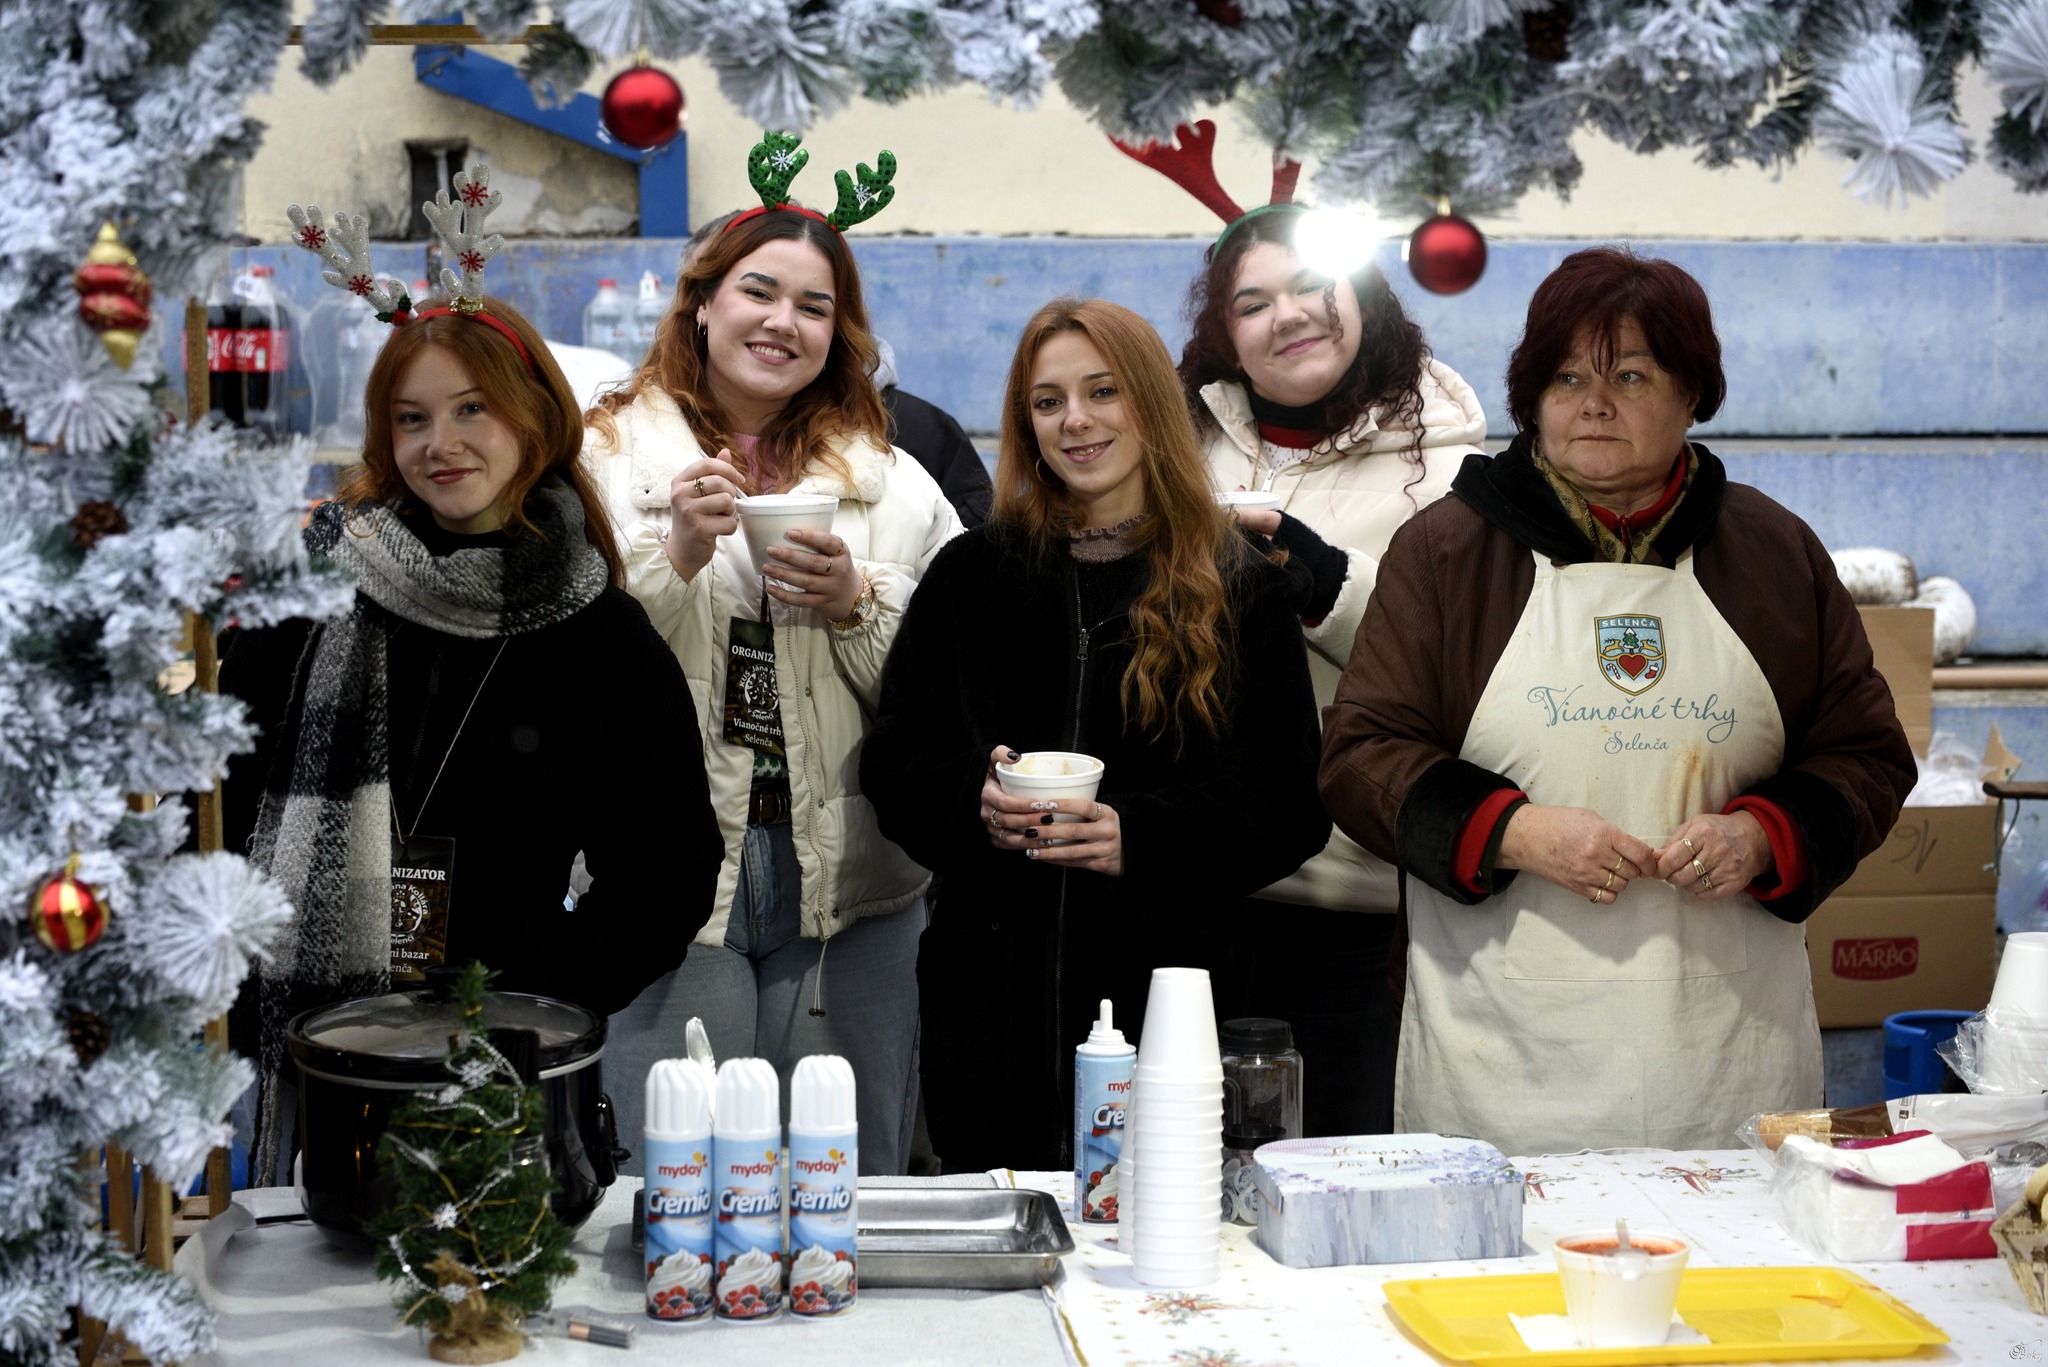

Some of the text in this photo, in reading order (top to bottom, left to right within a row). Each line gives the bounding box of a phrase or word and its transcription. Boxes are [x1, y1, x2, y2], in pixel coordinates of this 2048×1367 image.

[1601, 617, 1656, 628] SELENČA
[732, 645, 774, 663] ORGANIZ
[1527, 685, 1739, 744] Vianočné trhy
[733, 717, 769, 733] Vianočné
[745, 733, 773, 747] Selenča
[1604, 731, 1669, 755] Selenča
[392, 867, 446, 881] NIZATOR
[408, 885, 429, 915] Kollára
[390, 933, 415, 945] elenči
[401, 948, 430, 960] bazar
[1835, 942, 1917, 970] MARBO
[391, 963, 413, 974] enča
[1108, 1079, 1132, 1094] myd
[1094, 1105, 1127, 1128] Cre
[658, 1163, 703, 1179] myday
[730, 1163, 774, 1178] myday
[796, 1160, 839, 1175] myday
[647, 1187, 711, 1215] Cremio
[719, 1187, 780, 1215] Cremio
